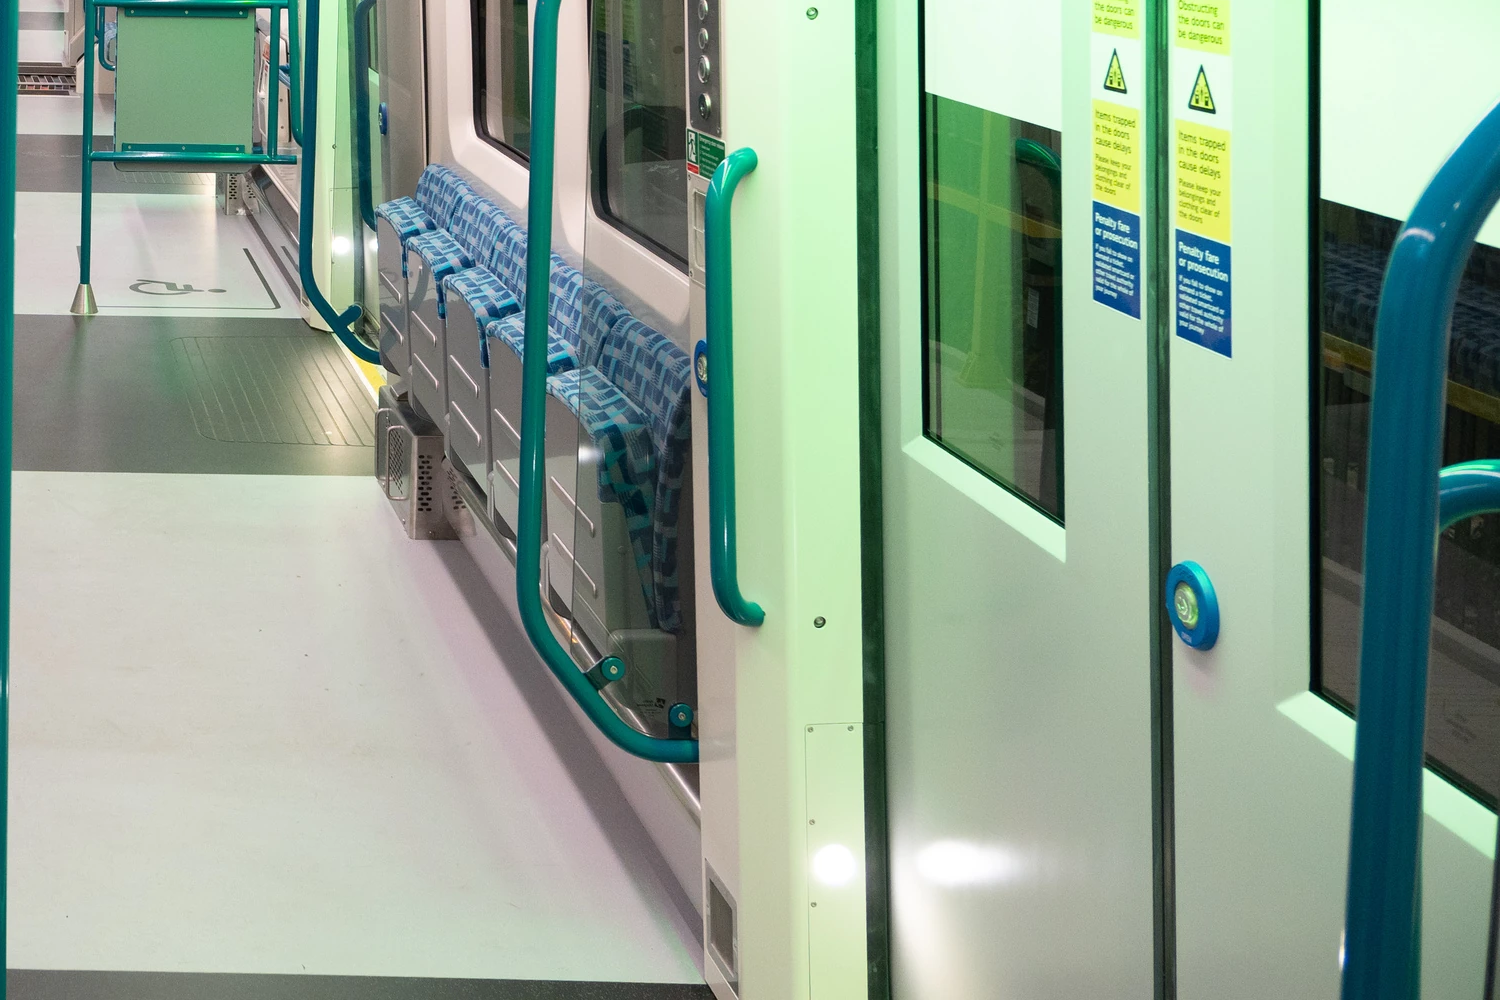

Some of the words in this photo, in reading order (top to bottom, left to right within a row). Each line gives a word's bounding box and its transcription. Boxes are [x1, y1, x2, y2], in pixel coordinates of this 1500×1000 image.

[1095, 1, 1104, 11] the
[1106, 3, 1122, 14] doors
[1124, 8, 1135, 16] can
[1178, 0, 1218, 18] Obstructing
[1095, 14, 1102, 24] be
[1104, 16, 1133, 30] dangerous
[1178, 14, 1189, 24] the
[1191, 16, 1210, 28] doors
[1212, 21, 1224, 30] can
[1178, 28, 1186, 39] be
[1188, 29, 1222, 44] dangerous
[1095, 109, 1111, 121] Items
[1113, 115, 1136, 128] trapped
[1095, 123, 1100, 132] in
[1102, 125, 1112, 135] the
[1113, 129, 1130, 140] doors
[1179, 130, 1197, 144] Items
[1199, 136, 1226, 151] trapped
[1095, 137, 1111, 148] cause
[1113, 141, 1132, 155] delays
[1178, 144, 1184, 154] in
[1186, 146, 1198, 158] the
[1200, 151, 1219, 164] doors
[1179, 160, 1197, 172] cause
[1199, 165, 1221, 180] delays
[1095, 212, 1117, 230] Penalty
[1118, 220, 1130, 233] fare
[1095, 228, 1102, 236] or
[1103, 230, 1138, 250] prosecution
[1179, 241, 1204, 261] Penalty
[1205, 250, 1219, 265] fare
[1179, 258, 1187, 267] or
[1187, 260, 1228, 282] prosecution
